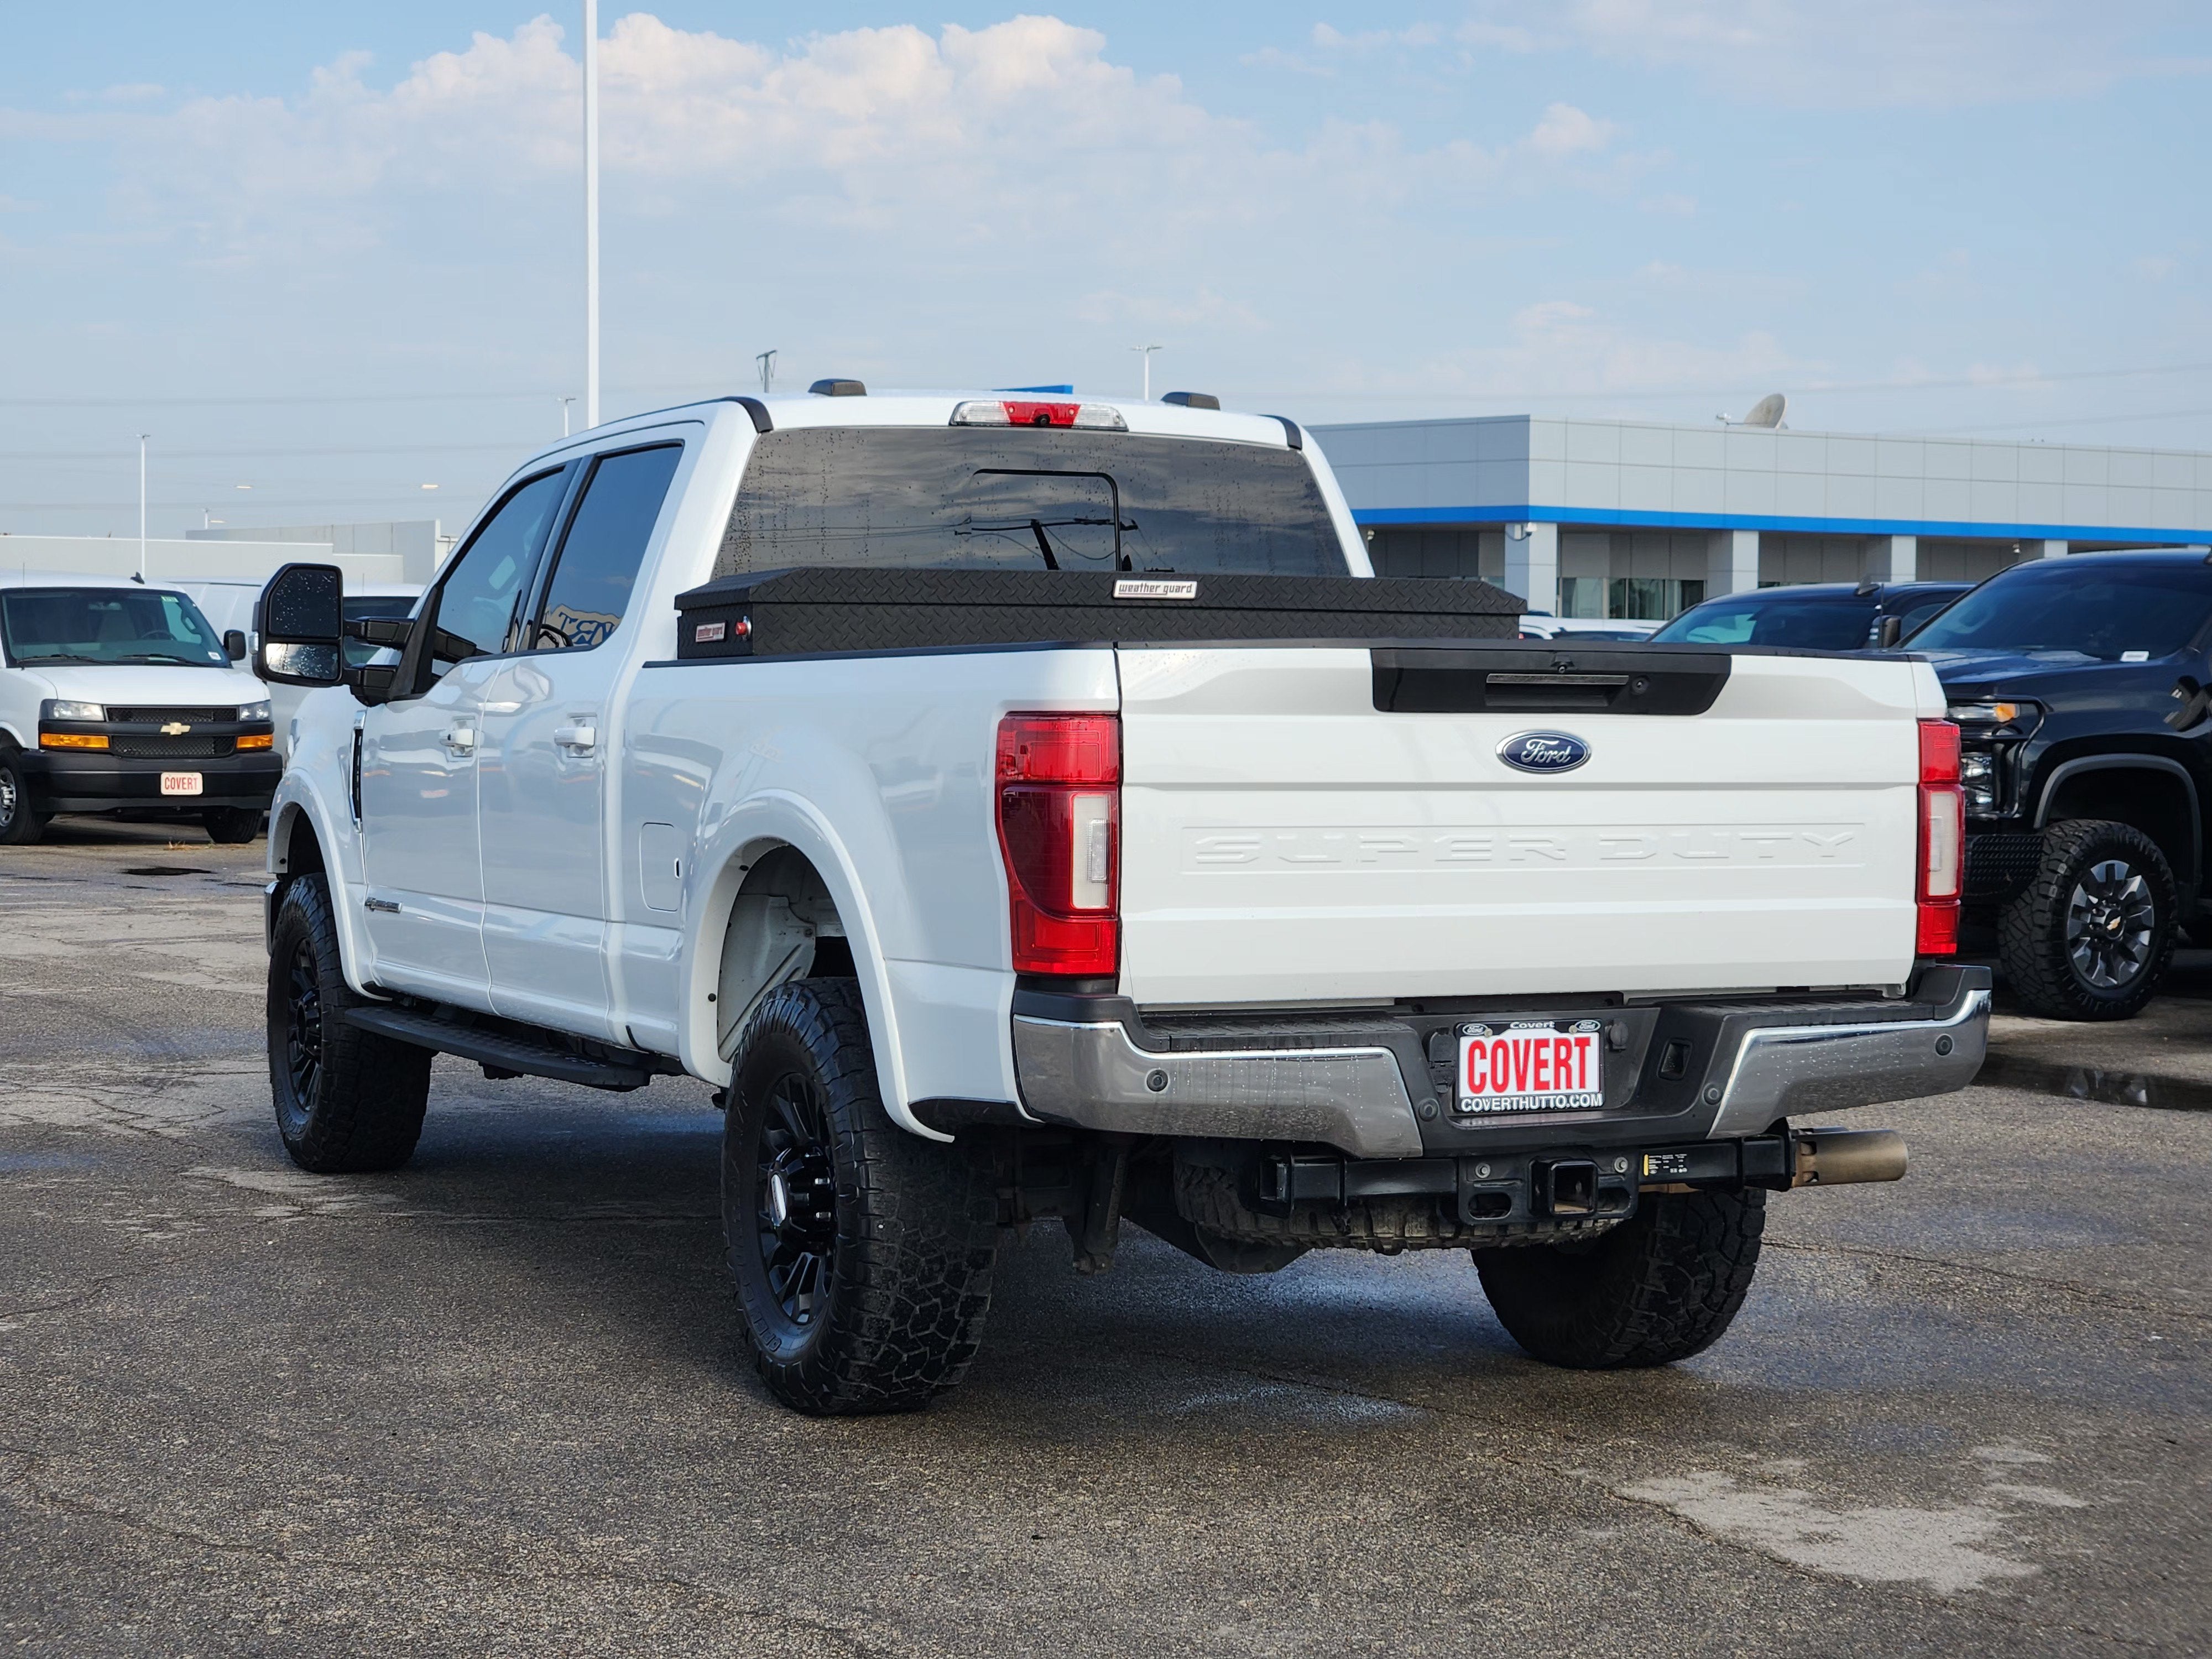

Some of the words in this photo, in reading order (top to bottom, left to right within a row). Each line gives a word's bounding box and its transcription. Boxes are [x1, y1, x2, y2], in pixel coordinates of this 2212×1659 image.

[1118, 582, 1161, 593] weather
[1162, 583, 1193, 594] guard
[1521, 738, 1572, 764] Ford
[164, 776, 198, 790] COVERT
[1194, 834, 1567, 864] SUPER
[1598, 831, 1854, 860] DUTY
[1510, 1021, 1555, 1029] Covert
[1467, 1036, 1592, 1094] COVERT
[1460, 1093, 1603, 1112] COVERTHUTTO.COM
